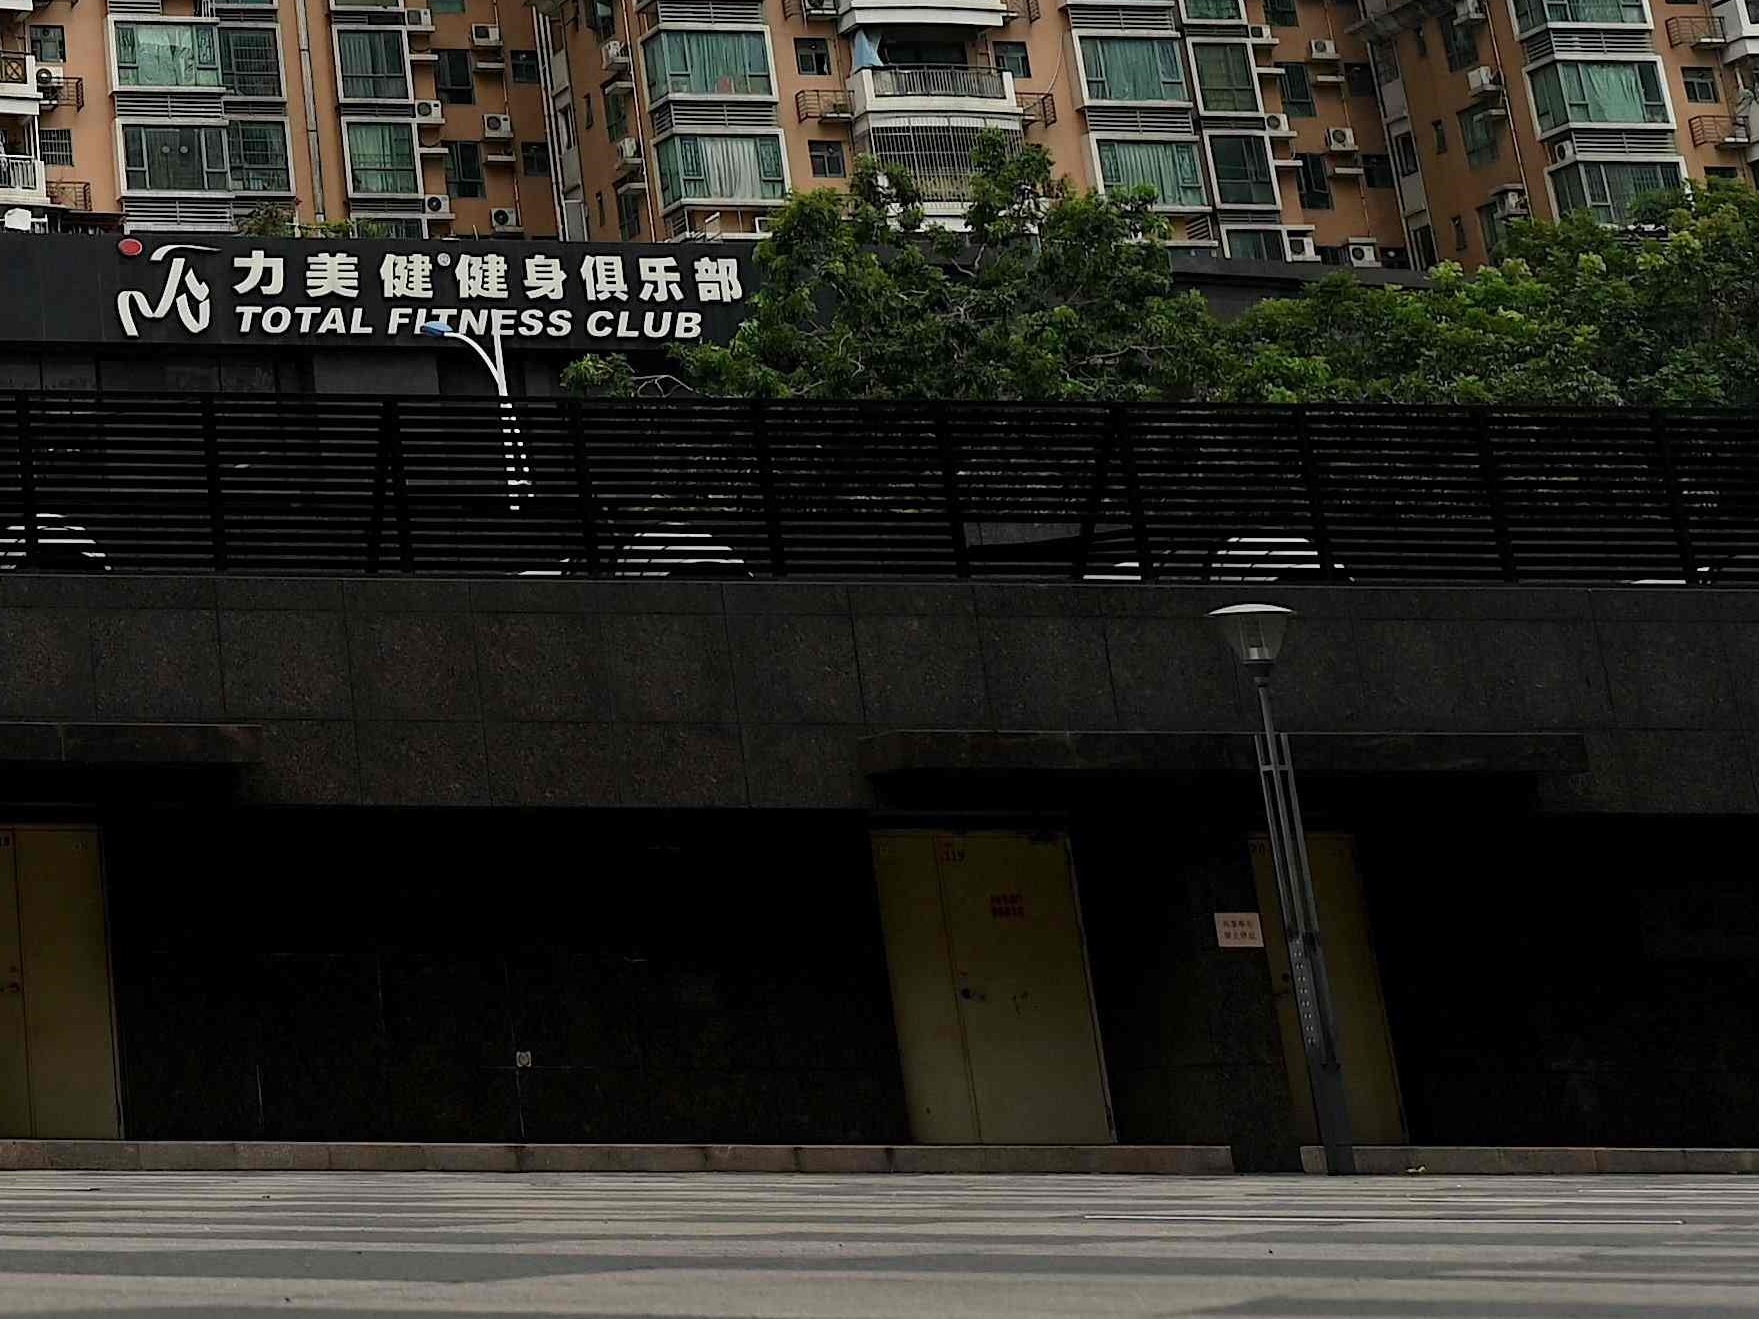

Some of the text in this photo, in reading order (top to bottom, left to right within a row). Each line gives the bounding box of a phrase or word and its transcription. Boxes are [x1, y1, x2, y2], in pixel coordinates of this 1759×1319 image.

[235, 306, 703, 339] TOTAL FITNESS CLUB
